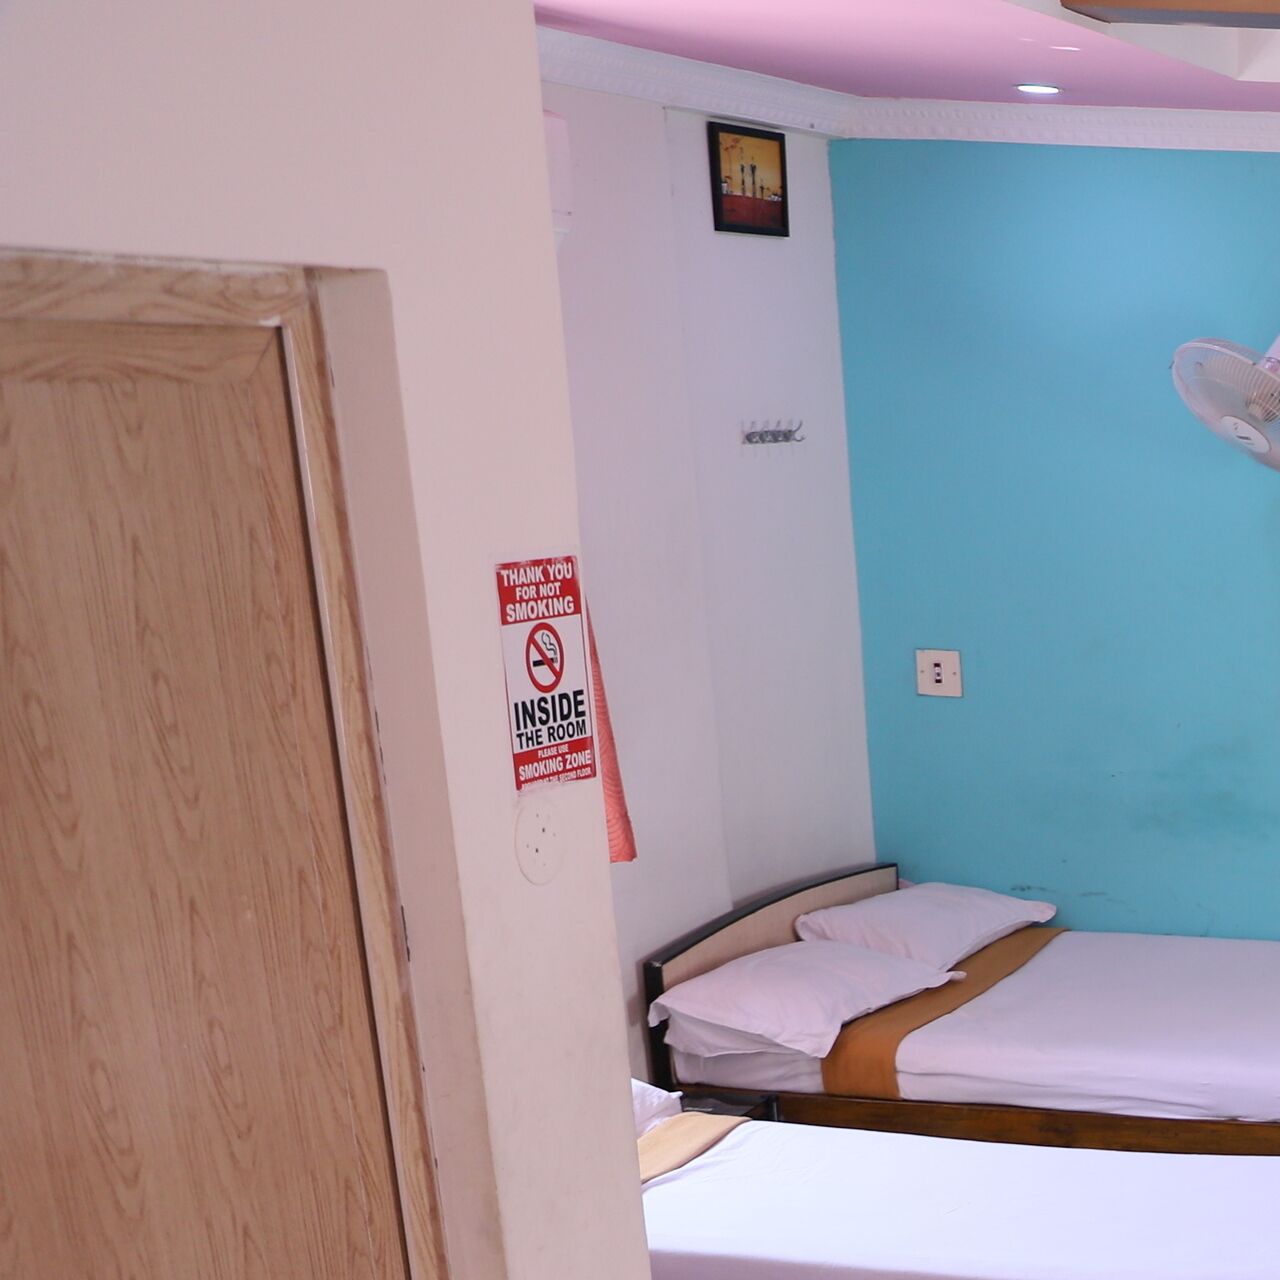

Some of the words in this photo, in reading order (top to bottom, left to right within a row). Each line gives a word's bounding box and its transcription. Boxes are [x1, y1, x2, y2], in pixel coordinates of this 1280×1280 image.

[501, 565, 545, 586] THANK
[547, 562, 572, 580] YOU
[516, 585, 537, 600] FOR
[540, 582, 561, 597] NOT
[506, 596, 574, 622] SMOKING
[514, 689, 586, 731] INSIDE
[516, 729, 543, 750] THE
[547, 719, 586, 742] ROOM
[538, 745, 557, 758] PLEASE
[519, 757, 563, 781] SMOKING
[565, 750, 591, 768] ZONE
